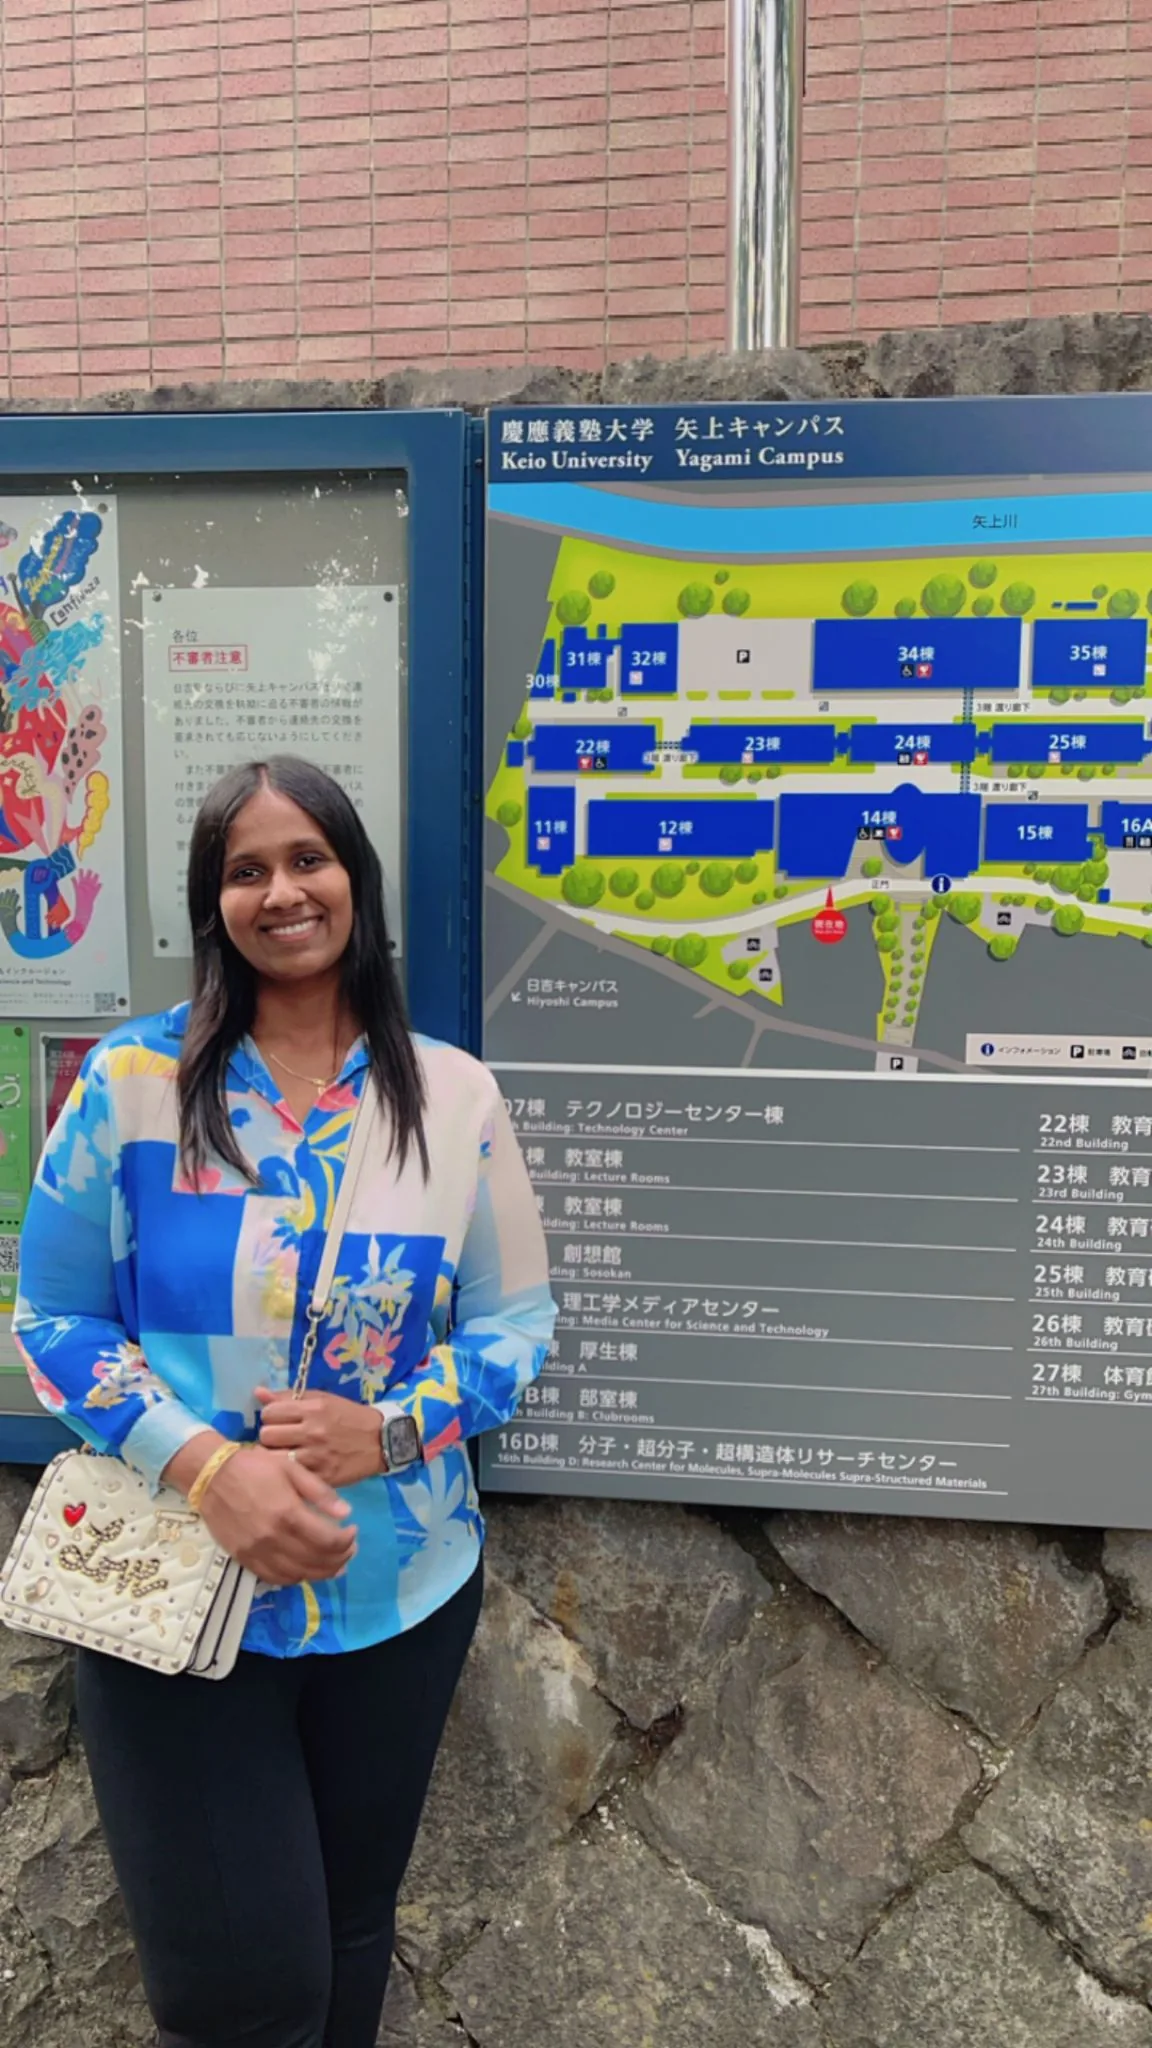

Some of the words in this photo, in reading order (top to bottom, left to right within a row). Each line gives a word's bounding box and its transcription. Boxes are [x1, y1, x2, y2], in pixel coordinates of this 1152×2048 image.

[501, 418, 654, 443] 慶應義塾大学
[674, 415, 844, 441] 矢上キャンパス
[501, 452, 547, 469] Keio
[552, 450, 653, 473] University
[675, 449, 751, 472] Yagami
[758, 447, 845, 470] Campus
[972, 514, 1018, 529] 矢上川
[172, 629, 198, 643] 各位
[173, 650, 242, 665] 不審者注意
[566, 652, 602, 667] 31棟
[631, 651, 667, 666] 32棟
[898, 646, 935, 662] 34棟
[1069, 645, 1108, 661] 35棟
[525, 674, 560, 689] 30棟
[575, 740, 611, 755] 22棟
[745, 737, 781, 752] 23棟
[894, 735, 931, 750] 24棟
[1049, 735, 1087, 750] 25棟
[862, 811, 897, 826] 14棟
[535, 820, 567, 834] 11棟
[659, 821, 693, 835] 12棟
[1017, 826, 1053, 840] 15棟
[527, 978, 618, 992] 日吉キャンパス
[527, 996, 570, 1009] Hiyoshi
[573, 996, 618, 1009] Campus
[566, 1099, 785, 1125] テクノロジーセンター棟
[522, 1121, 574, 1135] Building:
[578, 1122, 645, 1138] Technology
[649, 1124, 688, 1136] Center
[1038, 1113, 1090, 1134] 22棟
[1040, 1136, 1071, 1148] 22nd
[1075, 1138, 1129, 1153] Building
[564, 1148, 623, 1168] 教室棟
[529, 1169, 581, 1182] Building:
[584, 1171, 627, 1183] Lecture
[631, 1173, 670, 1184] Rooms
[1037, 1164, 1088, 1185] 23棟
[1038, 1187, 1068, 1199] 23rd
[1071, 1188, 1124, 1203] Building
[563, 1196, 623, 1216] 教室棟
[541, 1218, 580, 1232] ilding:
[583, 1219, 627, 1232] Lecture
[630, 1221, 669, 1233] Rooms
[1035, 1214, 1086, 1234] 24棟
[1107, 1216, 1152, 1237] 教育
[1037, 1237, 1065, 1248] 24th
[1069, 1237, 1122, 1252] Building
[563, 1244, 622, 1265] 創想館
[550, 1266, 580, 1280] ding:
[583, 1267, 631, 1279] Sosokan
[1033, 1265, 1084, 1284] 25棟
[1105, 1266, 1152, 1287] 教育
[1034, 1287, 1063, 1298] 25th
[1067, 1287, 1120, 1302] Building
[562, 1292, 780, 1317] 理工学メディアセンター
[583, 1315, 618, 1327] Media
[622, 1316, 662, 1328] Center
[664, 1318, 682, 1329] for
[686, 1319, 729, 1332] Science
[733, 1322, 756, 1333] and
[760, 1323, 829, 1339] Technology
[1031, 1314, 1083, 1334] 26棟
[579, 1341, 638, 1361] 厚生棟
[1033, 1336, 1062, 1348] 26th
[1066, 1337, 1119, 1352] Building
[540, 1361, 574, 1374] ilding
[578, 1363, 587, 1372] A
[1031, 1363, 1083, 1383] 27棟
[524, 1386, 560, 1405] B棟
[579, 1388, 638, 1409] 部室棟
[1031, 1385, 1060, 1396] 27th
[1063, 1386, 1120, 1401] Building:
[526, 1407, 574, 1421] Building
[577, 1411, 589, 1420] B:
[592, 1411, 655, 1424] Clubrooms
[498, 1432, 559, 1452] 16D棟
[498, 1453, 520, 1464] 16th
[522, 1454, 566, 1468] Building
[568, 1456, 580, 1466] D:
[582, 1457, 629, 1470] Research
[631, 1459, 666, 1472] Center
[669, 1461, 685, 1472] for
[747, 1466, 837, 1481] Supra-Molecules
[839, 1471, 932, 1486] Supra-Structured
[935, 1476, 988, 1489] Materials
